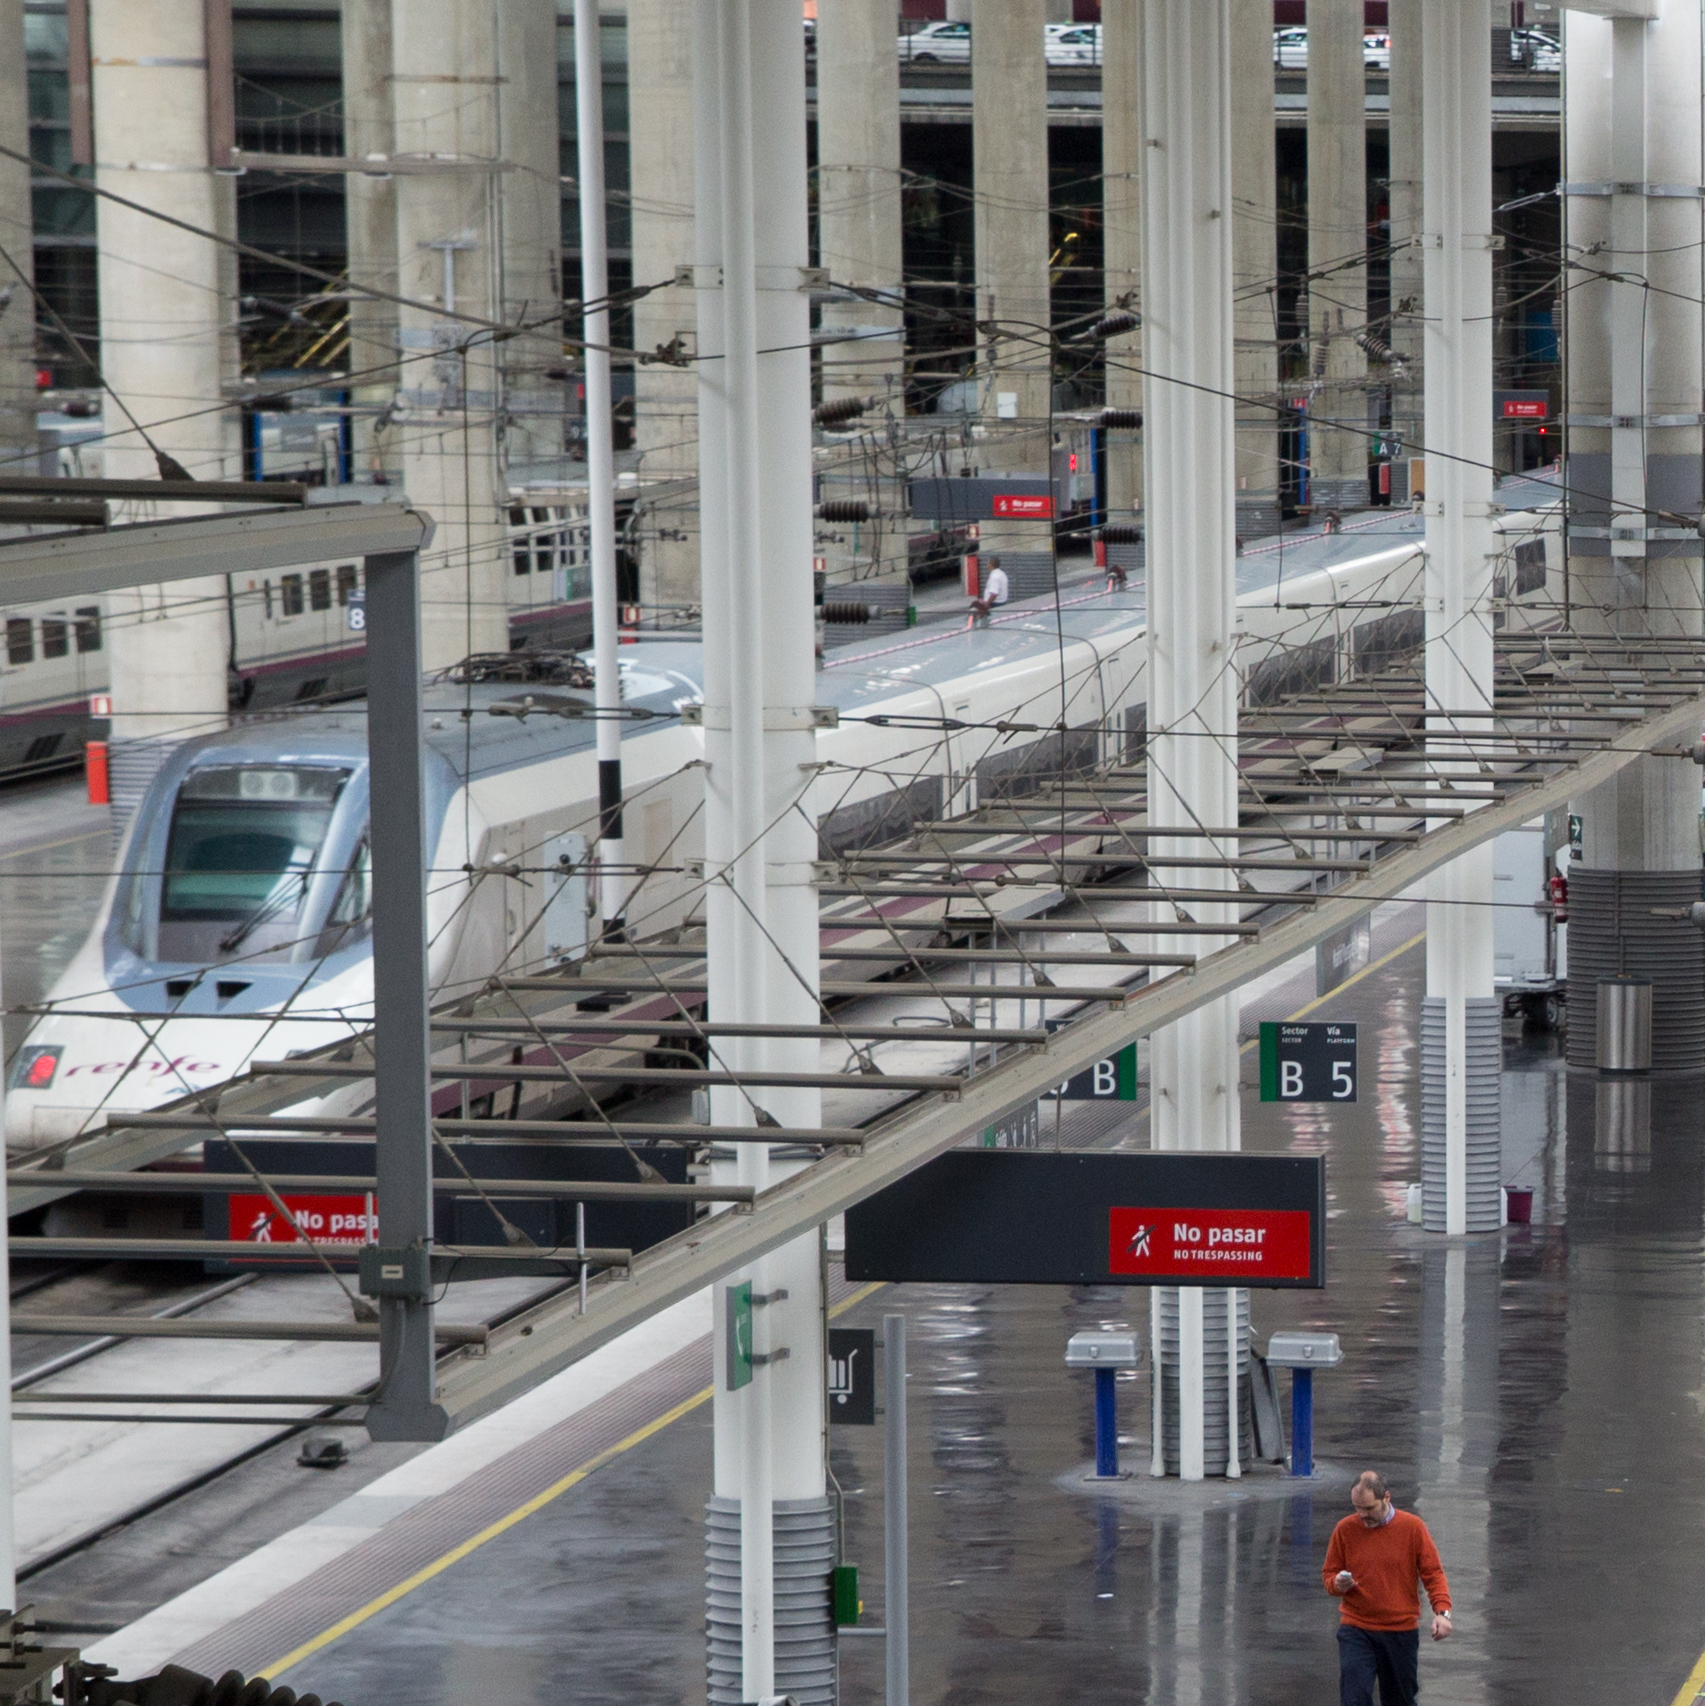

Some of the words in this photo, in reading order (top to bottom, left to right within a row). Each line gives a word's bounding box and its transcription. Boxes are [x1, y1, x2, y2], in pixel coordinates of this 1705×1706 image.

[1379, 442, 1387, 454] A
[1282, 1027, 1308, 1035] Sector
[64, 1055, 220, 1078] renfe
[1093, 1058, 1116, 1095] B
[1281, 1061, 1303, 1097] B
[1332, 1061, 1353, 1098] 5
[295, 1210, 324, 1229] No
[1174, 1223, 1200, 1241] No
[1208, 1227, 1266, 1246] pasar
[1174, 1250, 1188, 1259] NO
[1191, 1250, 1263, 1261] TRESPASSING
